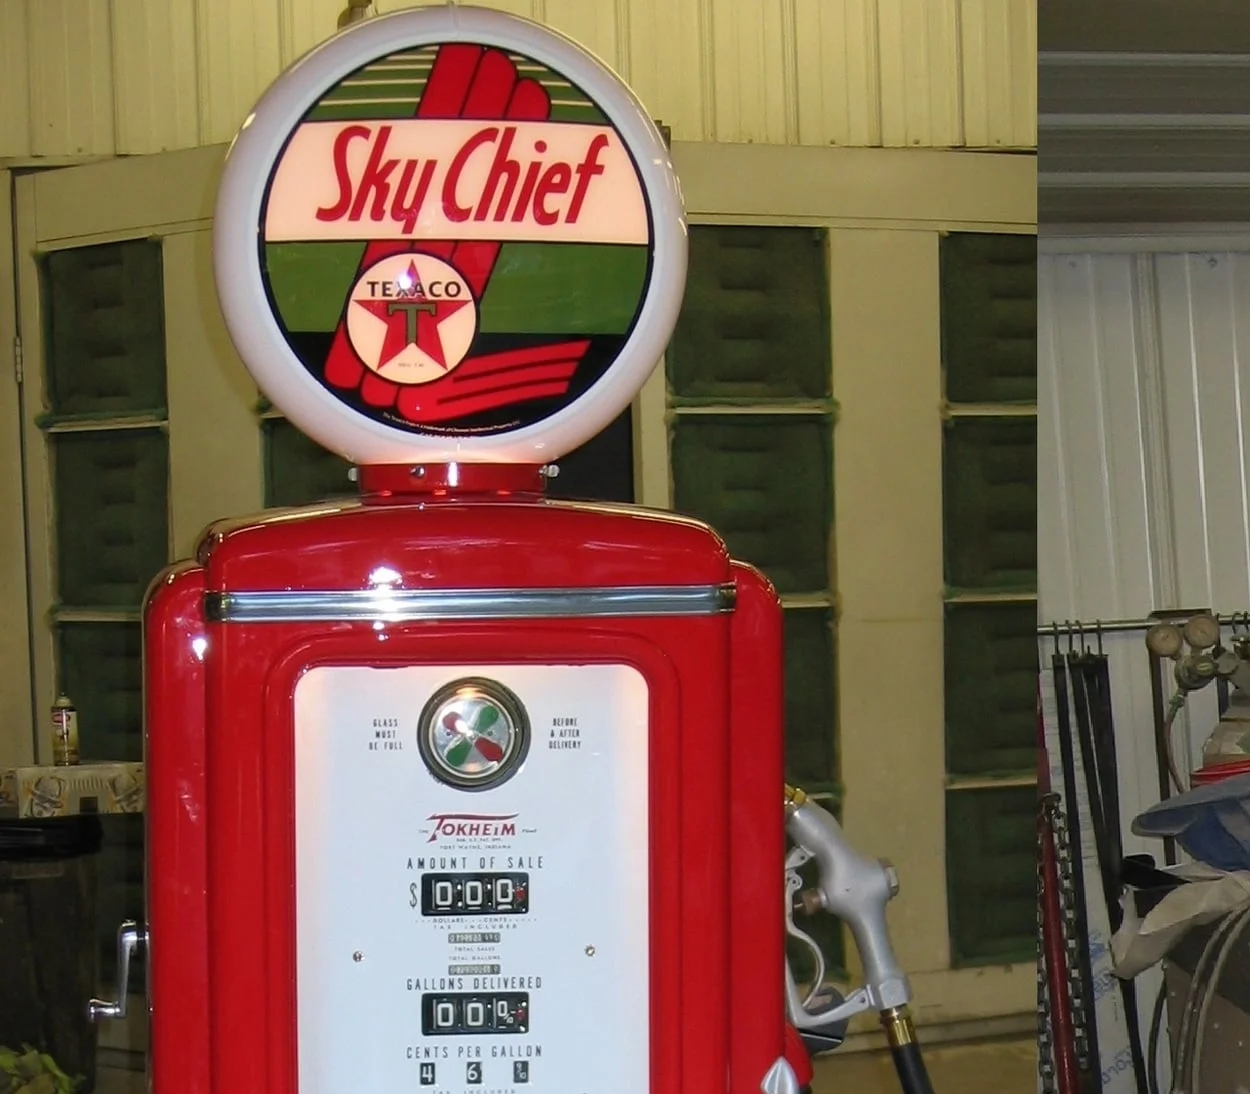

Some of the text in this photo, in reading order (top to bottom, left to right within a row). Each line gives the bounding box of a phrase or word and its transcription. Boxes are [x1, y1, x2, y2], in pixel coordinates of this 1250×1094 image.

[316, 126, 609, 234] Sky Chief
[365, 281, 462, 298] TEXACO
[426, 813, 520, 844] TOKHEIM
[407, 856, 544, 869] AMOUNT OF SALE
[409, 883, 418, 908] $
[406, 976, 542, 991] GALLONS DELIVERED
[406, 1045, 542, 1059] CENTS PER GALLON
[422, 1065, 433, 1082] 4
[467, 1064, 478, 1080] 6
